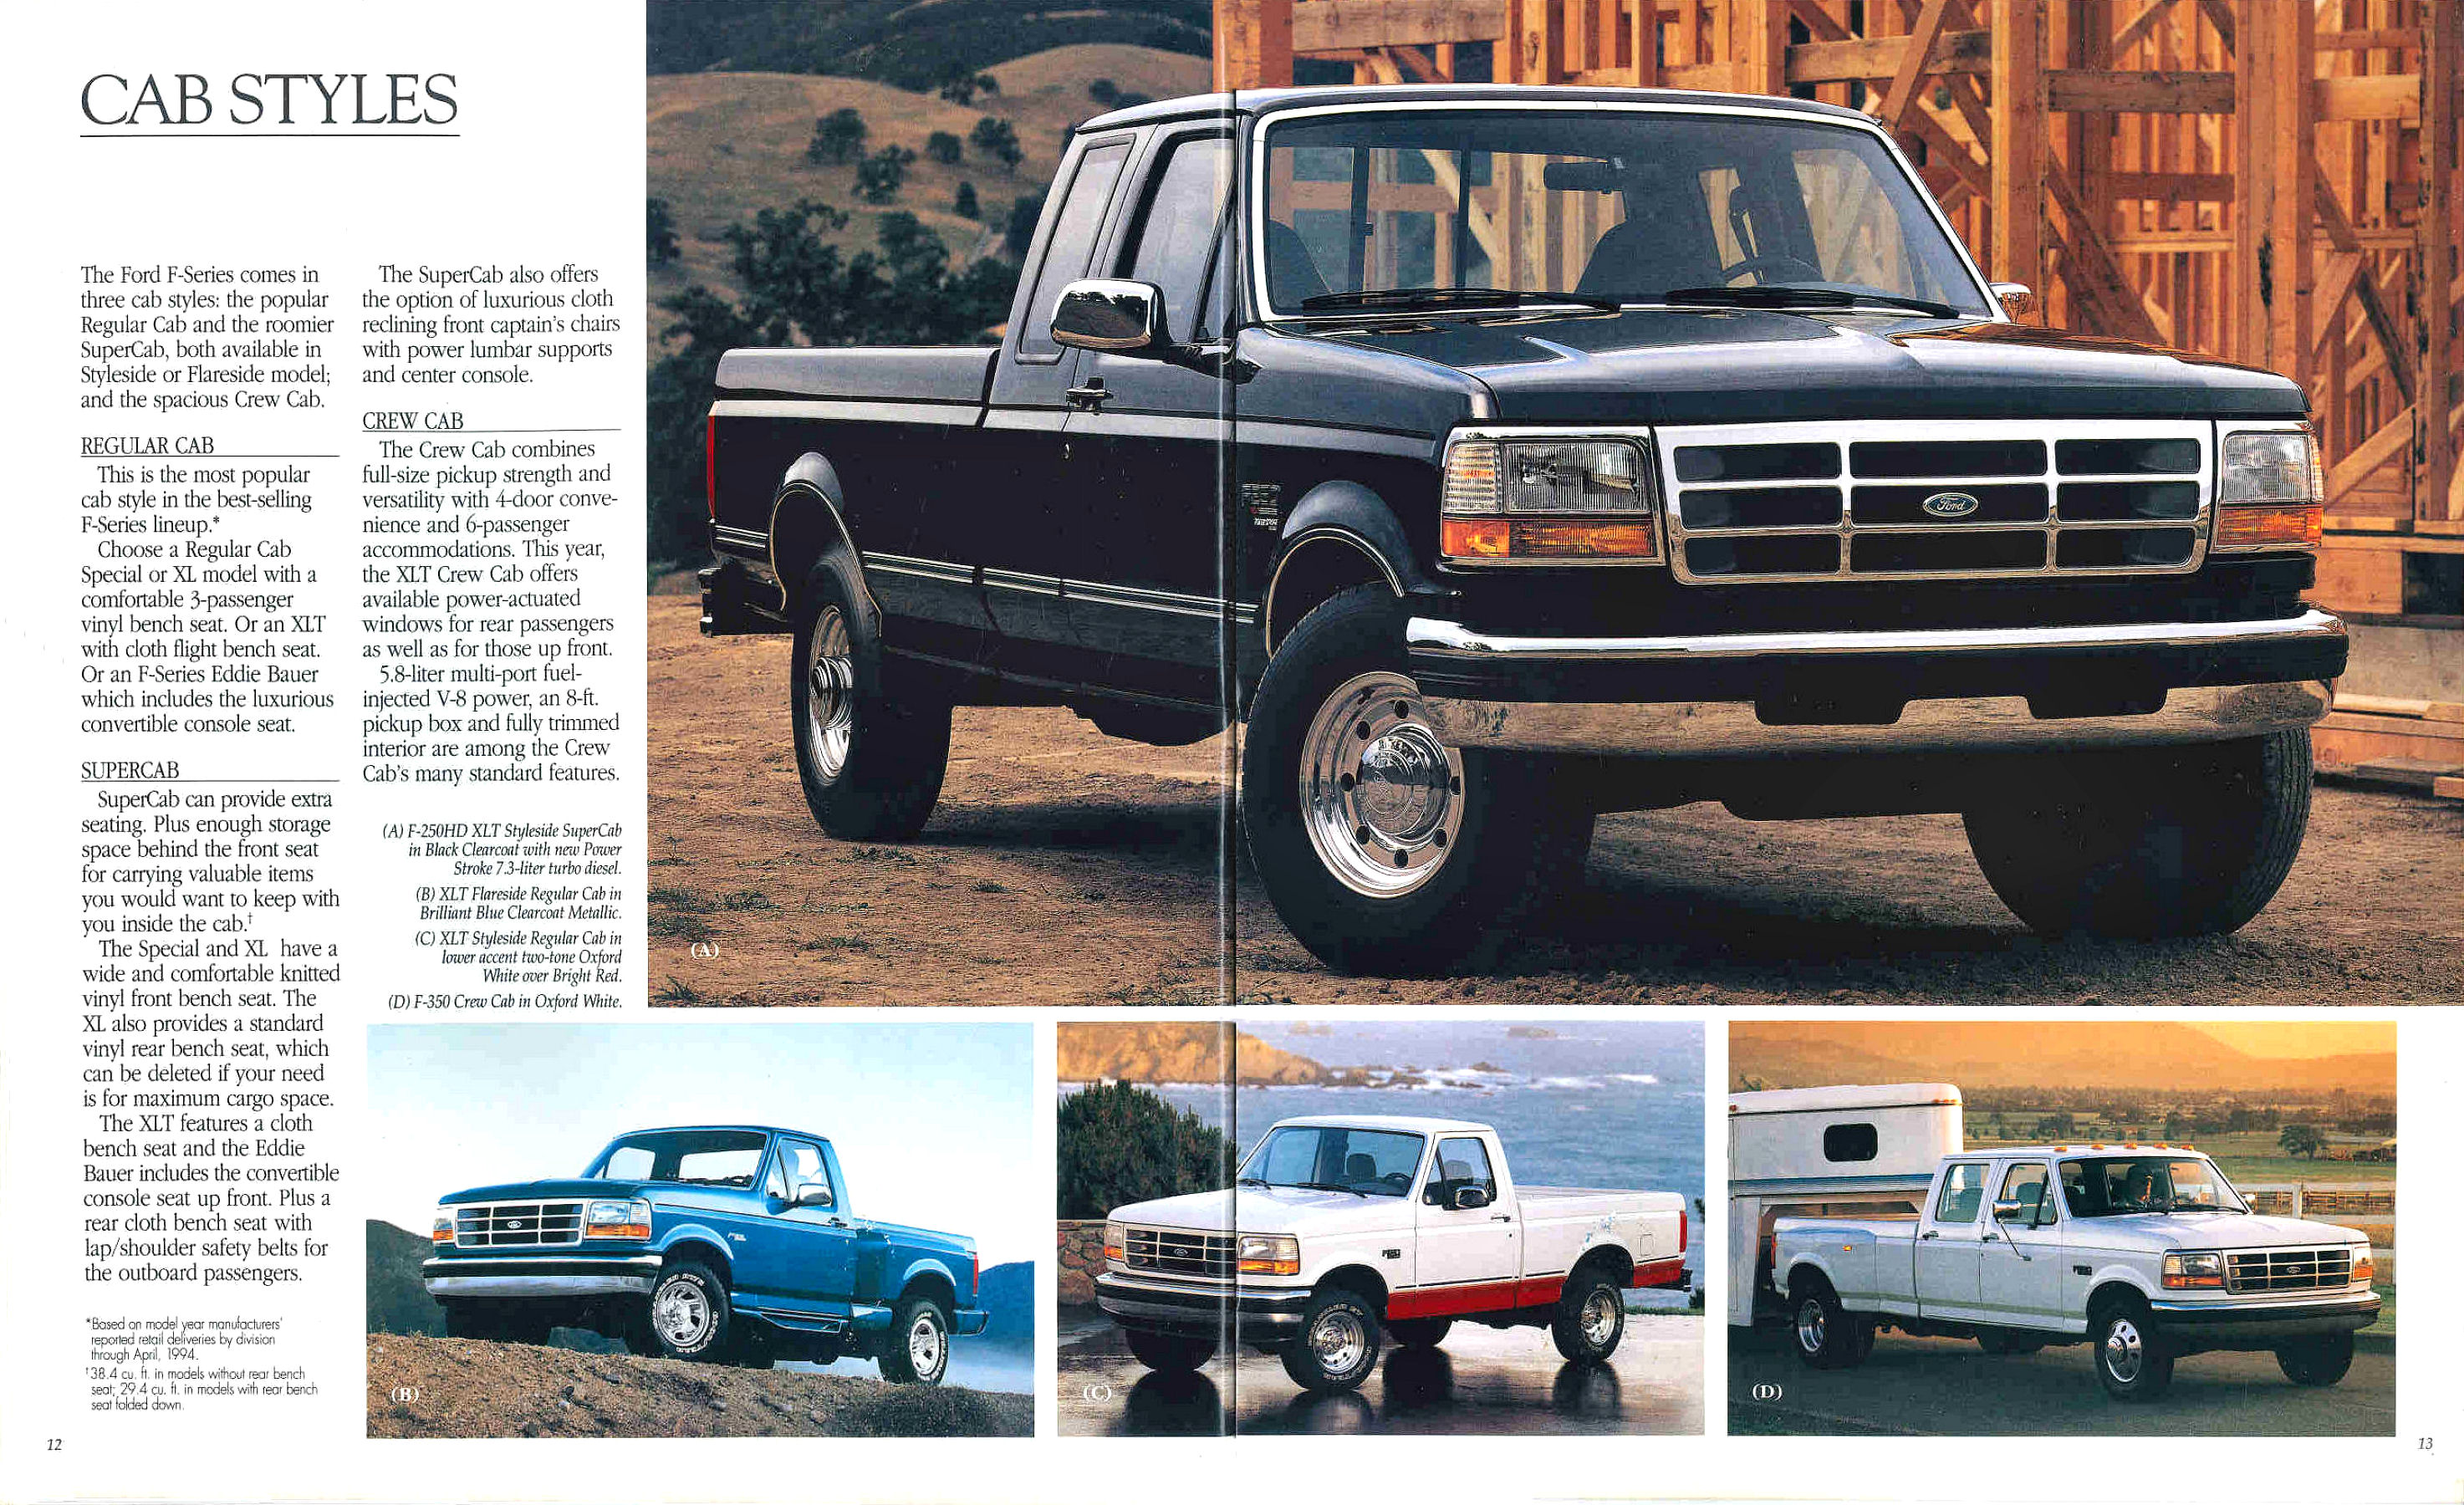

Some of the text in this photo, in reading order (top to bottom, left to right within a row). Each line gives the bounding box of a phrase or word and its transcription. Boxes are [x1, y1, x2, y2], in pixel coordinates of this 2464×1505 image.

[81, 73, 457, 125] CAB STYLES
[80, 264, 319, 283] The Ford F-Series comes in
[80, 288, 329, 314] three cab styles: the popular
[362, 288, 613, 314] the option of luxurious cloth
[81, 314, 335, 339] Regular Cab and the roomier
[362, 314, 437, 339] reclining
[443, 314, 485, 334] front
[570, 314, 620, 333] chairs
[81, 339, 322, 364] SuperCab, both available in
[80, 364, 330, 389] Styleside or Flareside model;
[80, 388, 325, 413] and the spacious Crew Cab.
[362, 411, 464, 430] CREW CAB
[80, 436, 215, 455] REGULAR CAB
[1936, 497, 1967, 511] Ford
[380, 662, 583, 687] 5.8-liter multi-port fuel-
[363, 687, 599, 713] injected V-8 power, an 8-ft.
[81, 760, 180, 779] SUPERCAB
[98, 788, 333, 814] SuperCab can provide extra
[81, 814, 331, 839] seating. Plus enough storage
[383, 822, 622, 842] (A) F-250HD XLT Styleside SuperCab
[408, 841, 623, 857] in Black Clearcoat with new Power
[453, 860, 622, 875] Stroke 7.3-liter turbo diesel.
[416, 885, 622, 906] (B) XLT Flareside Regular Cab in
[420, 904, 622, 921] Brilliant Blue Clearcoat Metallic.
[415, 930, 622, 950] (C) XLT Styleside Regular Cab in
[441, 948, 622, 968] lower accent two-tone Oxford
[691, 941, 719, 959] (A)
[483, 967, 622, 987] White over Bright Red.
[388, 992, 622, 1013] (D) F-350 Crew Cab in Oxford White.
[85, 1237, 329, 1262] lap/shoulder safety belts for
[84, 1262, 302, 1287] the outboard passengers.
[129, 1321, 142, 1330] on
[145, 1316, 178, 1330] model
[181, 1321, 206, 1333] year
[91, 1331, 275, 1349] reported retail deliveries by division
[91, 1348, 199, 1365] through April, 1994.
[121, 1370, 137, 1380] cu.
[140, 1366, 150, 1380] ft.
[155, 1367, 164, 1379] in
[167, 1366, 205, 1380] models
[208, 1367, 245, 1380] without
[248, 1370, 269, 1380] rear
[273, 1366, 306, 1380] bench
[91, 1382, 318, 1396] seat; 29.4 cu. ft. in models with rear bench
[391, 1387, 420, 1404] (B)
[1084, 1385, 1112, 1402] (C)
[1752, 1384, 1783, 1401] (D)
[91, 1397, 185, 1411] seat folded down.
[47, 1438, 63, 1451] 12
[2419, 1437, 2433, 1450] 13
